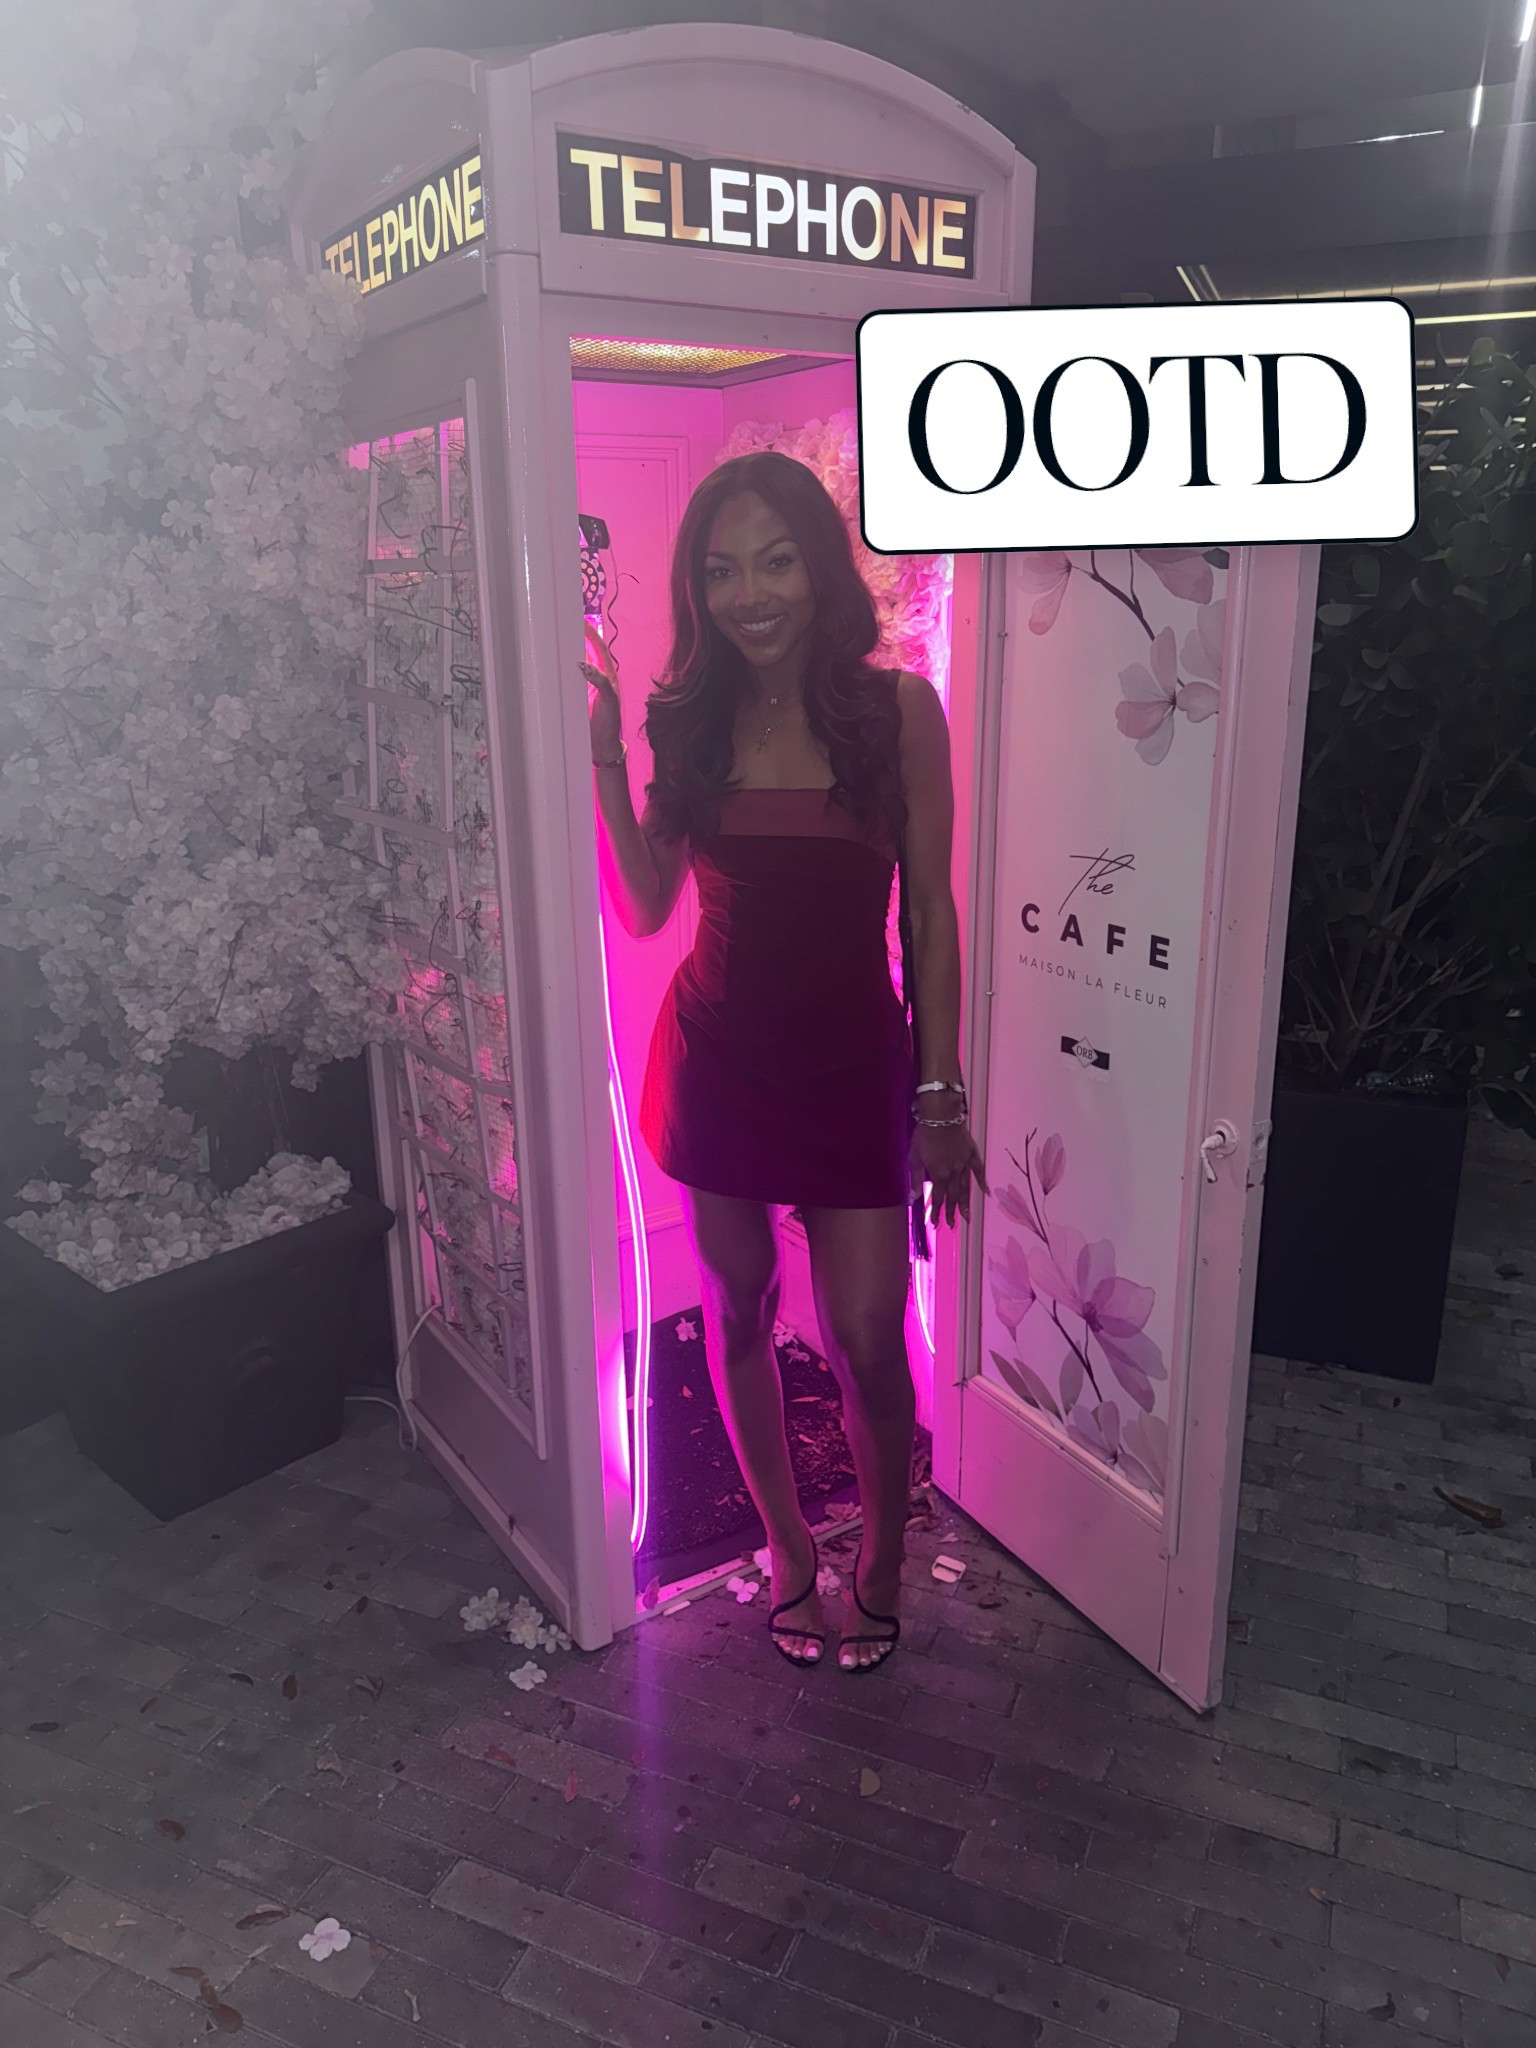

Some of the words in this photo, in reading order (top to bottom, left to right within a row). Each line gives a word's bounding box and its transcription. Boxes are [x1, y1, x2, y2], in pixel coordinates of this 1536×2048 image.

[570, 149, 967, 269] TELEPHONE
[1021, 903, 1170, 970] CAFE
[1019, 954, 1076, 980] MAISON
[1085, 974, 1104, 989] LA
[1113, 982, 1167, 1009] FLEUR
